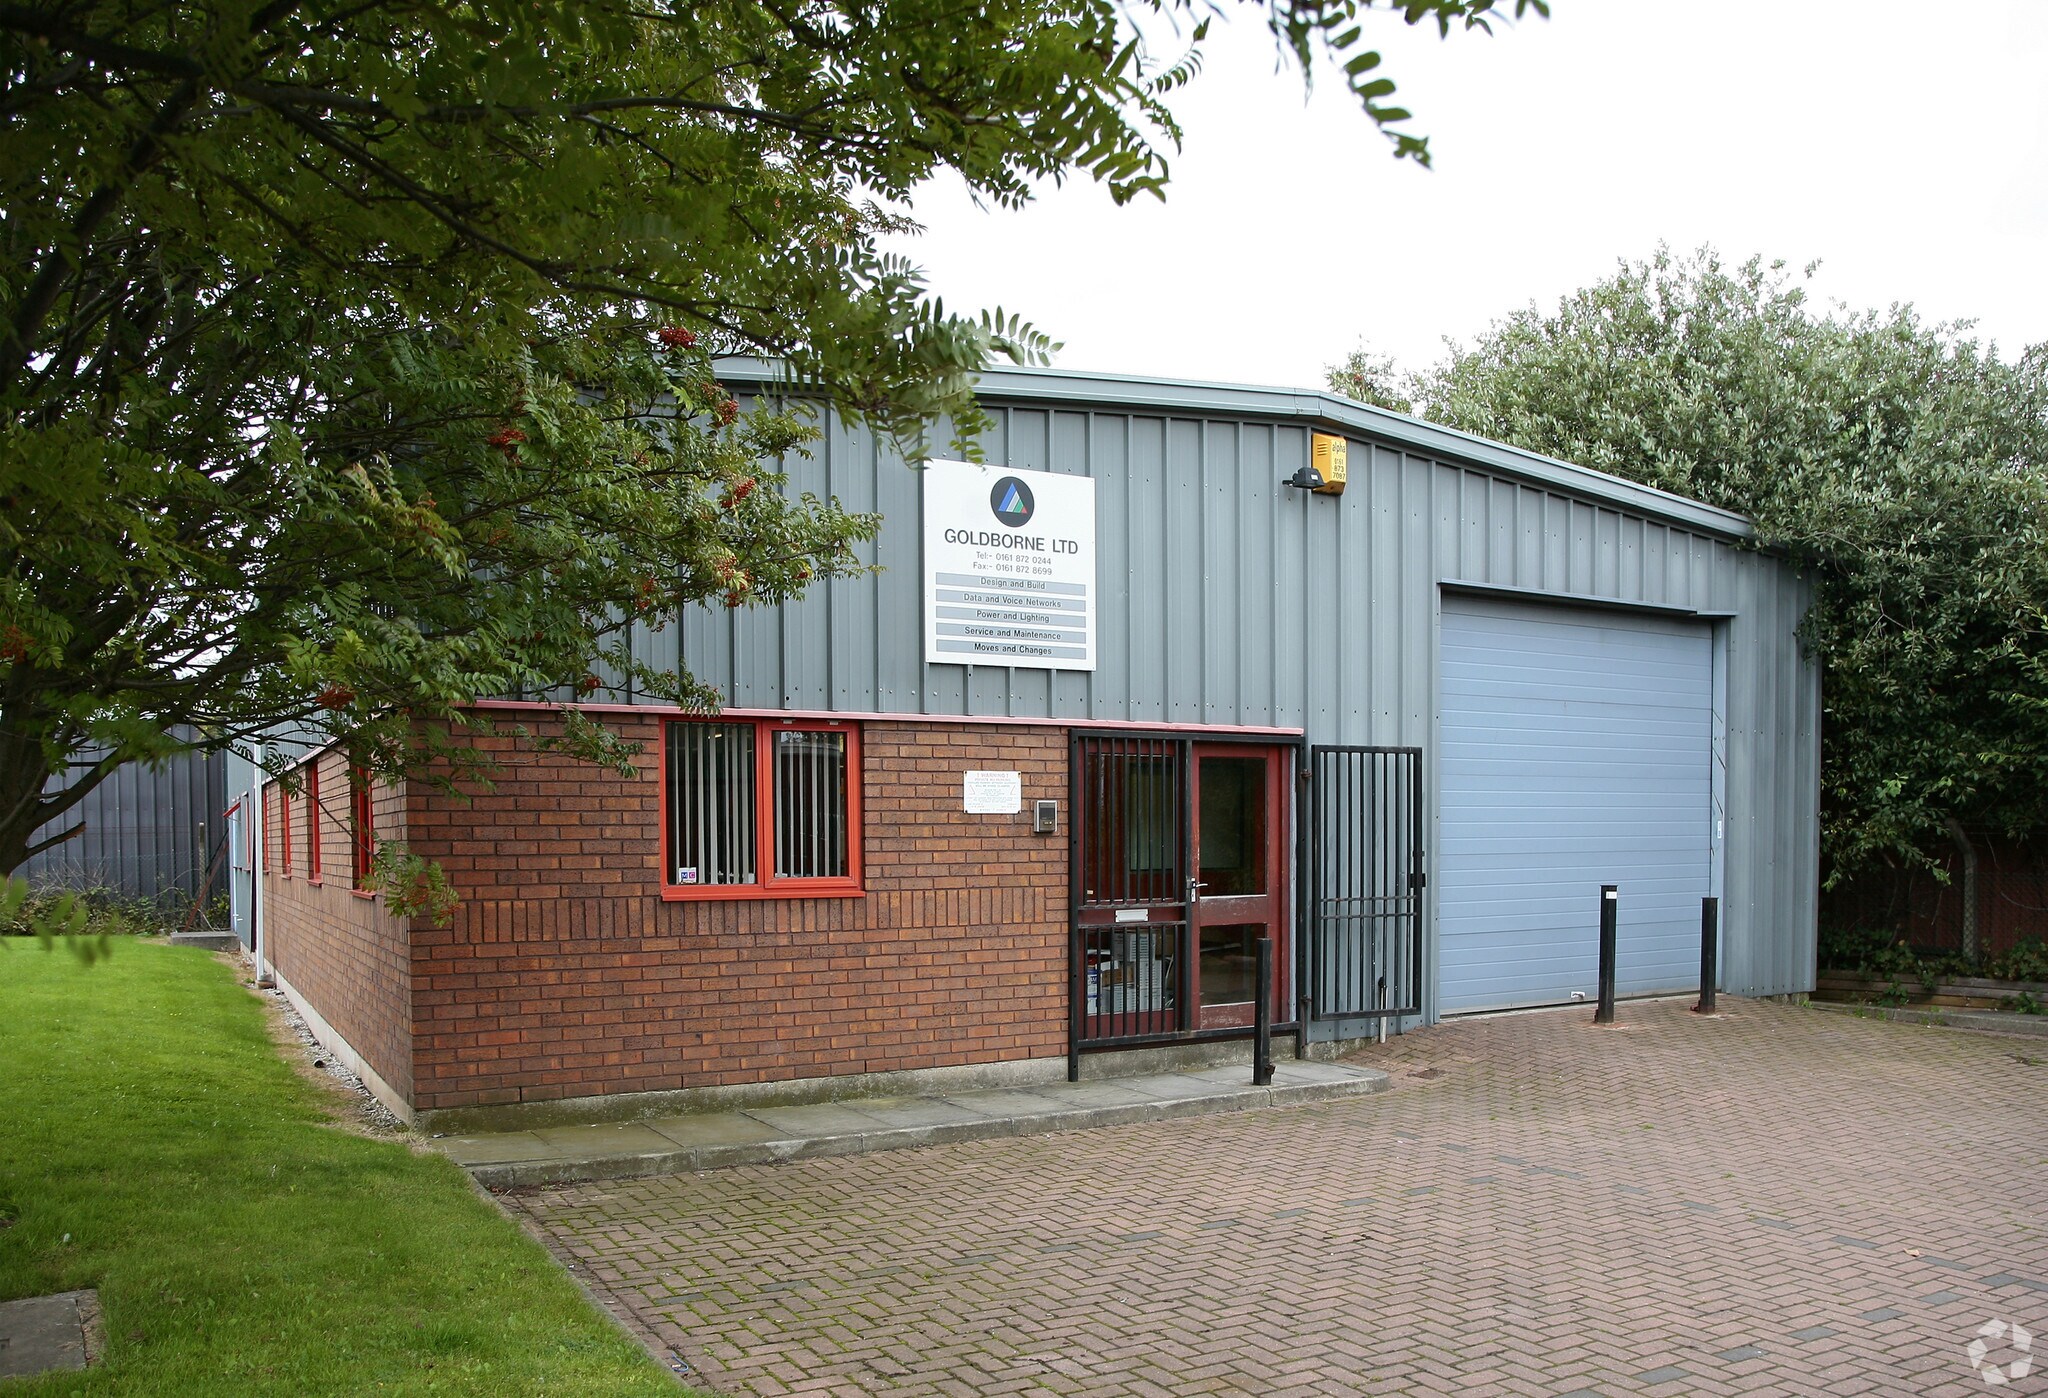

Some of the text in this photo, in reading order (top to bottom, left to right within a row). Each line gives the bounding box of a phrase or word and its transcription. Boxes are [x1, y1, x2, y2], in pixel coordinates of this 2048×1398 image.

[944, 528, 1078, 554] GOLDBORNE LTD
[996, 553, 1013, 562] 0161
[1015, 555, 1029, 563] 872
[1032, 556, 1051, 565] 0244
[996, 563, 1013, 572] 0161
[1015, 565, 1029, 573] 872
[1032, 567, 1052, 576] 8699
[980, 577, 1007, 588] Design
[1027, 581, 1046, 590] Build
[963, 593, 1061, 608] Data and Voice Networks
[976, 610, 1000, 619] Power
[1020, 613, 1050, 624] Lighting
[964, 626, 1061, 640] Service and Maintenance
[974, 643, 1052, 656] Moves and Changes
